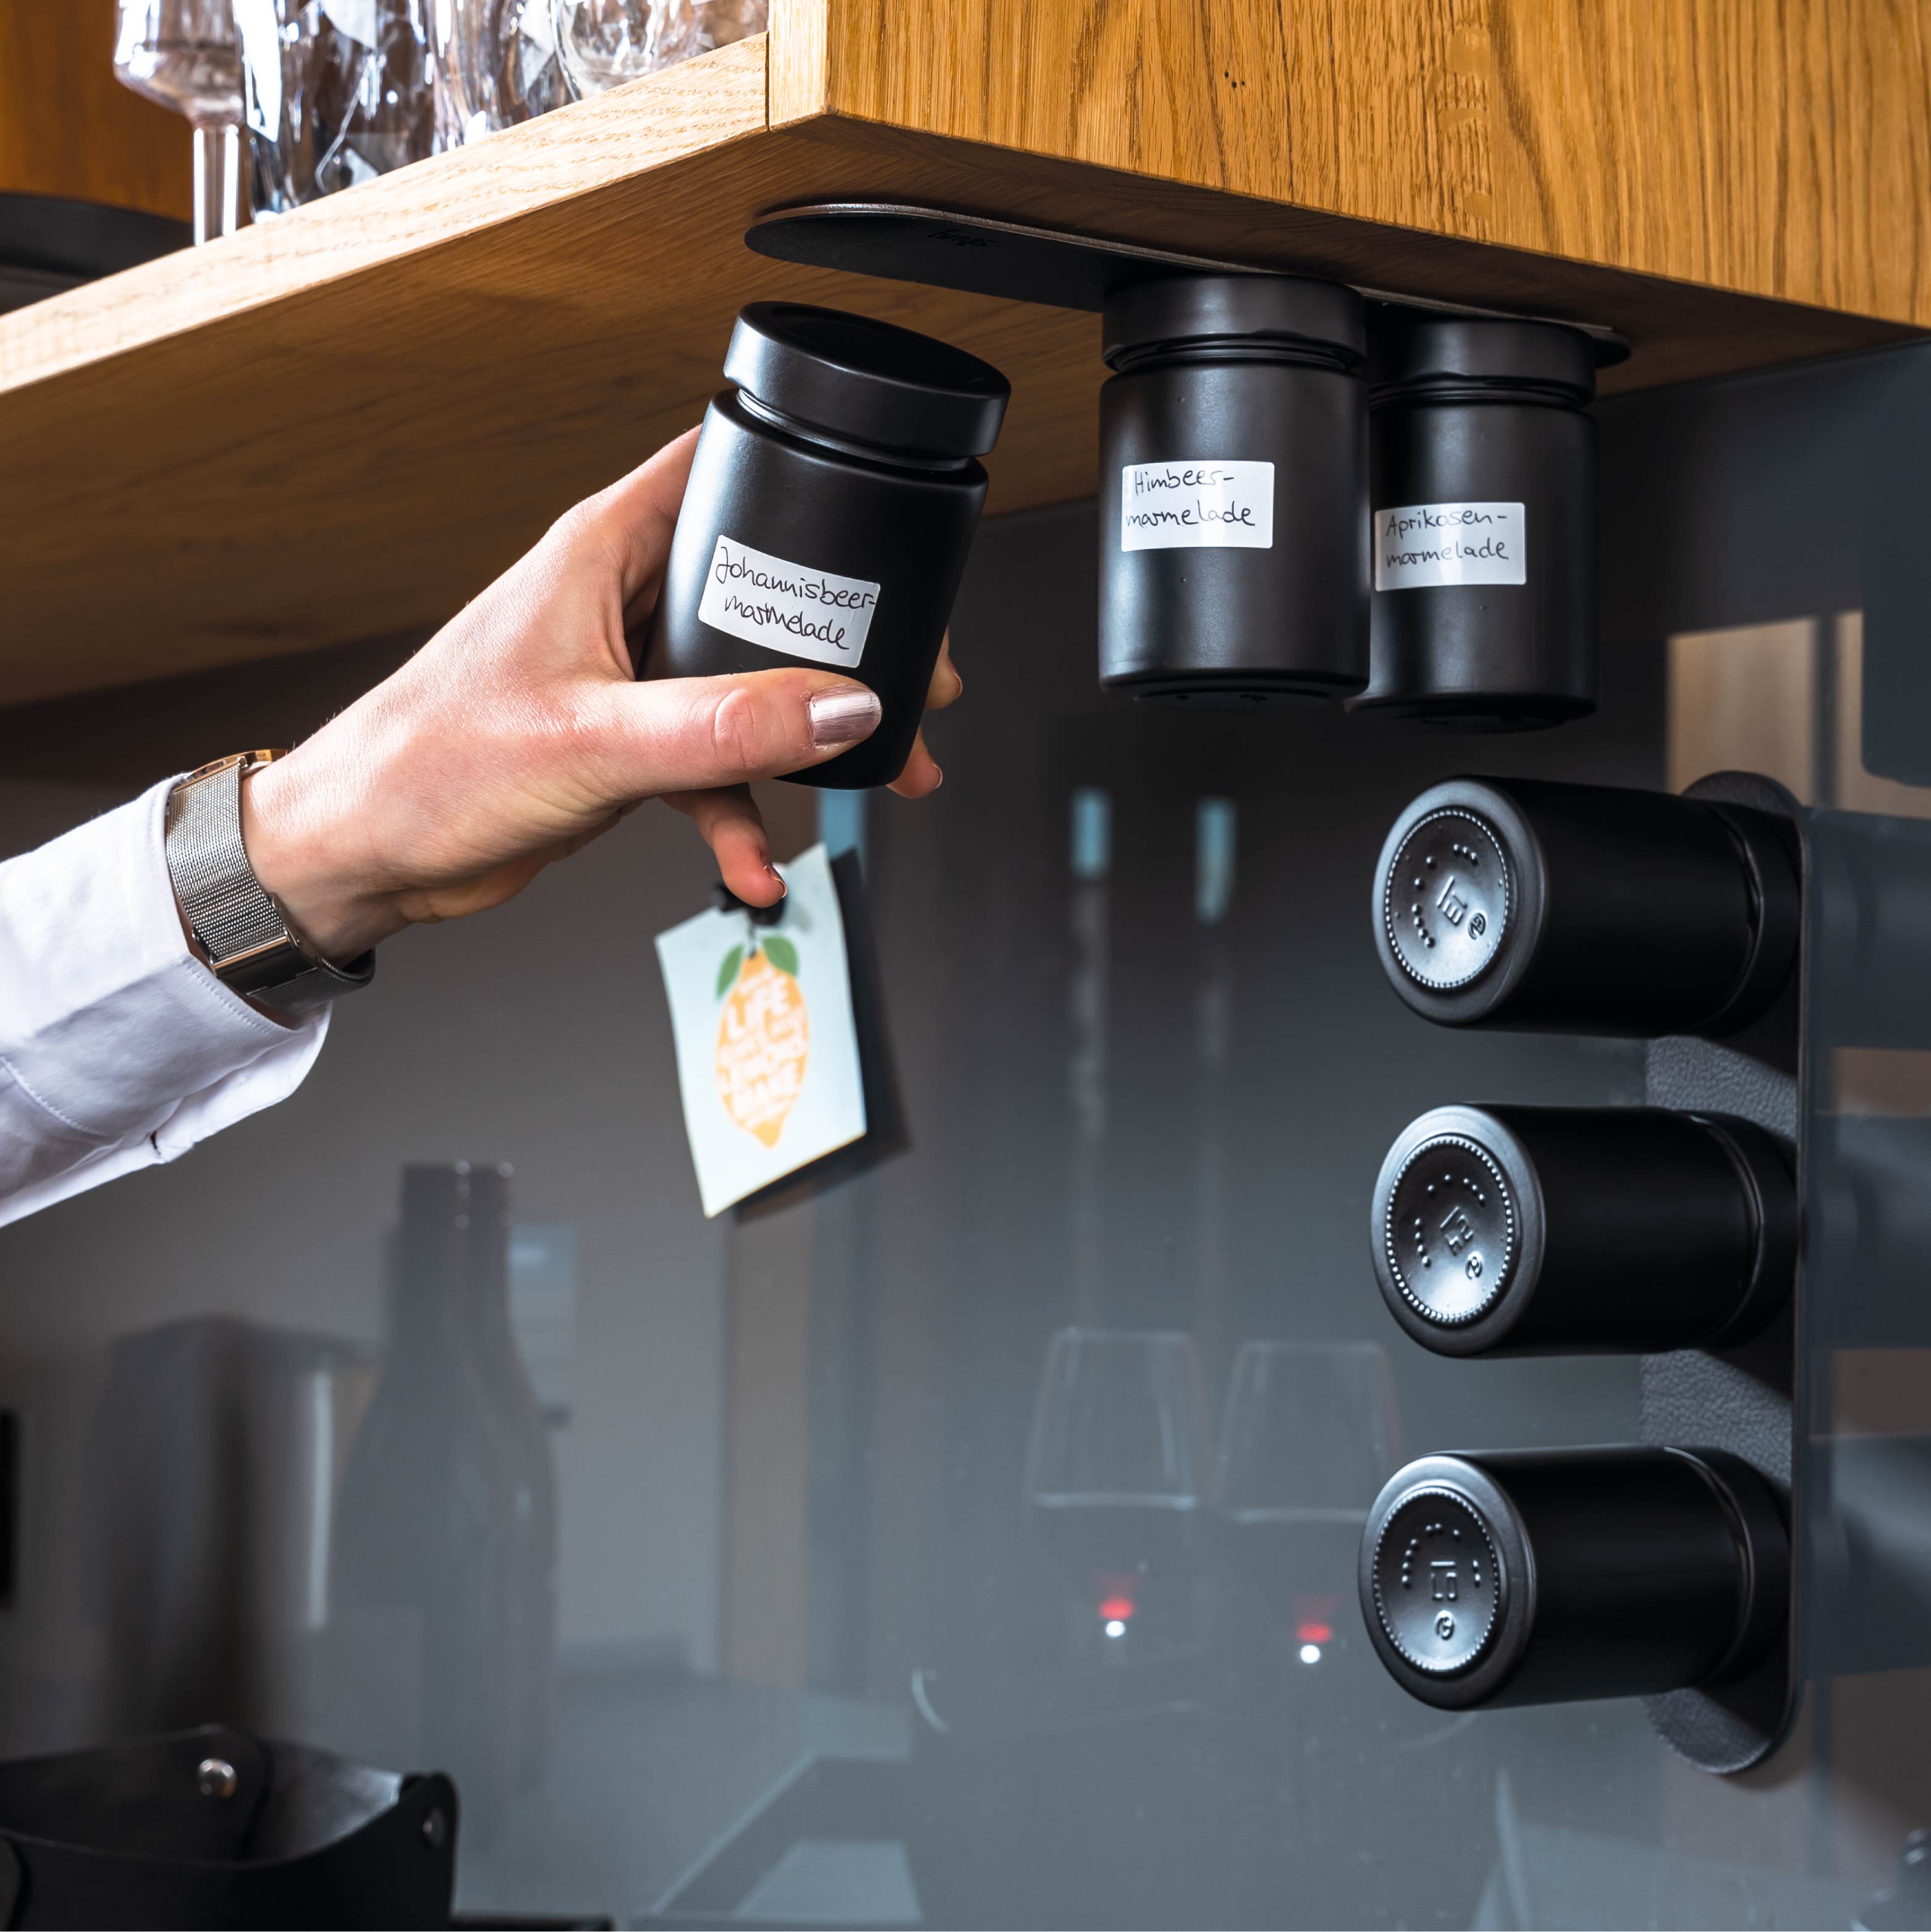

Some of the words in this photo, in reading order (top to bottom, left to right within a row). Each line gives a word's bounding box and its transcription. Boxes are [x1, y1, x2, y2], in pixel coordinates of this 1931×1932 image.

[1135, 468, 1235, 497] Himbeer-
[1126, 499, 1256, 528] marmelade
[1385, 509, 1508, 540] Aprikosen-
[1386, 537, 1509, 569] marmelade
[716, 546, 876, 609] Johannisbeer-
[724, 595, 850, 650] marmelade
[725, 973, 790, 1040] LIFE
